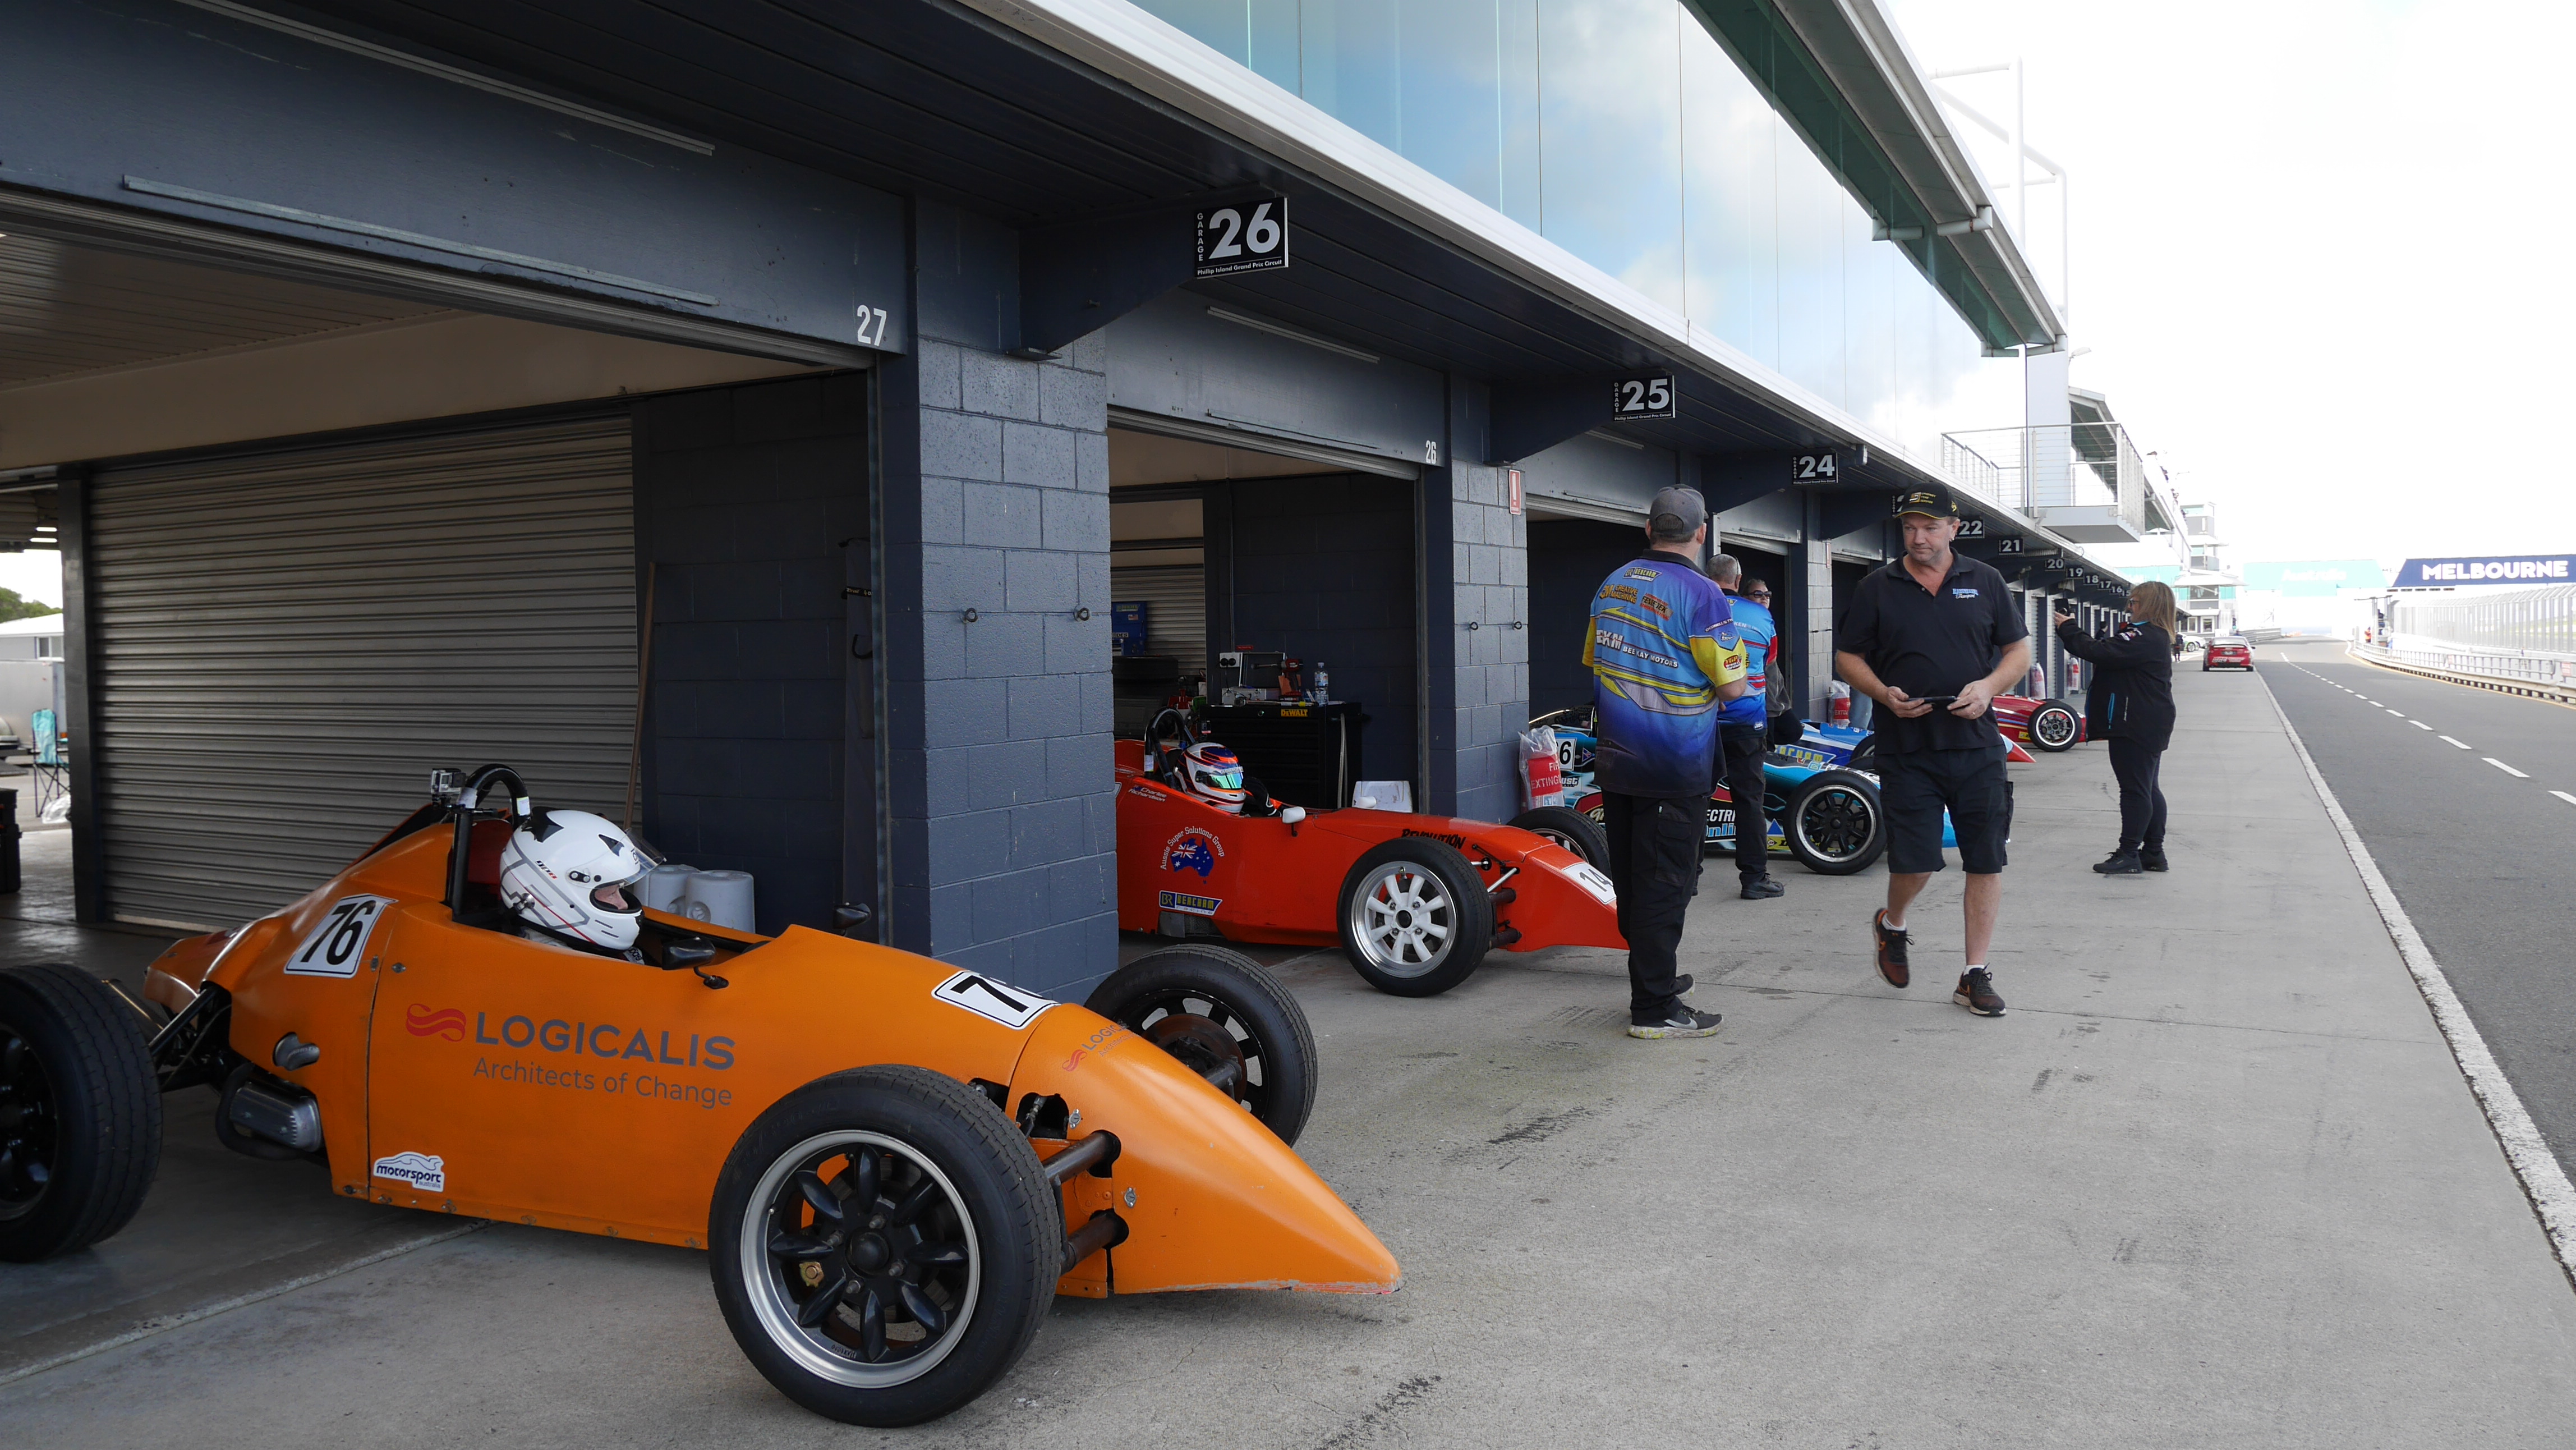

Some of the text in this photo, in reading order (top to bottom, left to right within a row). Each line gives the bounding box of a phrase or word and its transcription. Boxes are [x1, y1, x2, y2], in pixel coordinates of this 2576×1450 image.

[1208, 203, 1281, 259] 26
[857, 305, 887, 346] 27
[1622, 378, 1669, 411] 25
[1425, 440, 1437, 464] 26
[1799, 455, 1835, 478] 24
[1958, 520, 1982, 535] 22
[2002, 539, 2020, 552] 21
[2048, 559, 2064, 568] 20
[2069, 568, 2083, 577] 19
[2422, 560, 2568, 580] MELBOURNE
[1622, 646, 1635, 655] BEE
[1650, 655, 1678, 668] MOTORS
[1556, 741, 1572, 765] 6
[1549, 761, 1560, 772] FIR
[1160, 825, 1225, 870] Aussie Super Solutions Group
[1579, 868, 1613, 892] 14
[1177, 894, 1214, 909] BEACHAM
[300, 900, 376, 965] 76
[950, 975, 1043, 1013] 7
[476, 1012, 735, 1070] LOGICALIS
[473, 1057, 733, 1110] Architects of Change
[376, 1165, 441, 1184] motorsport
